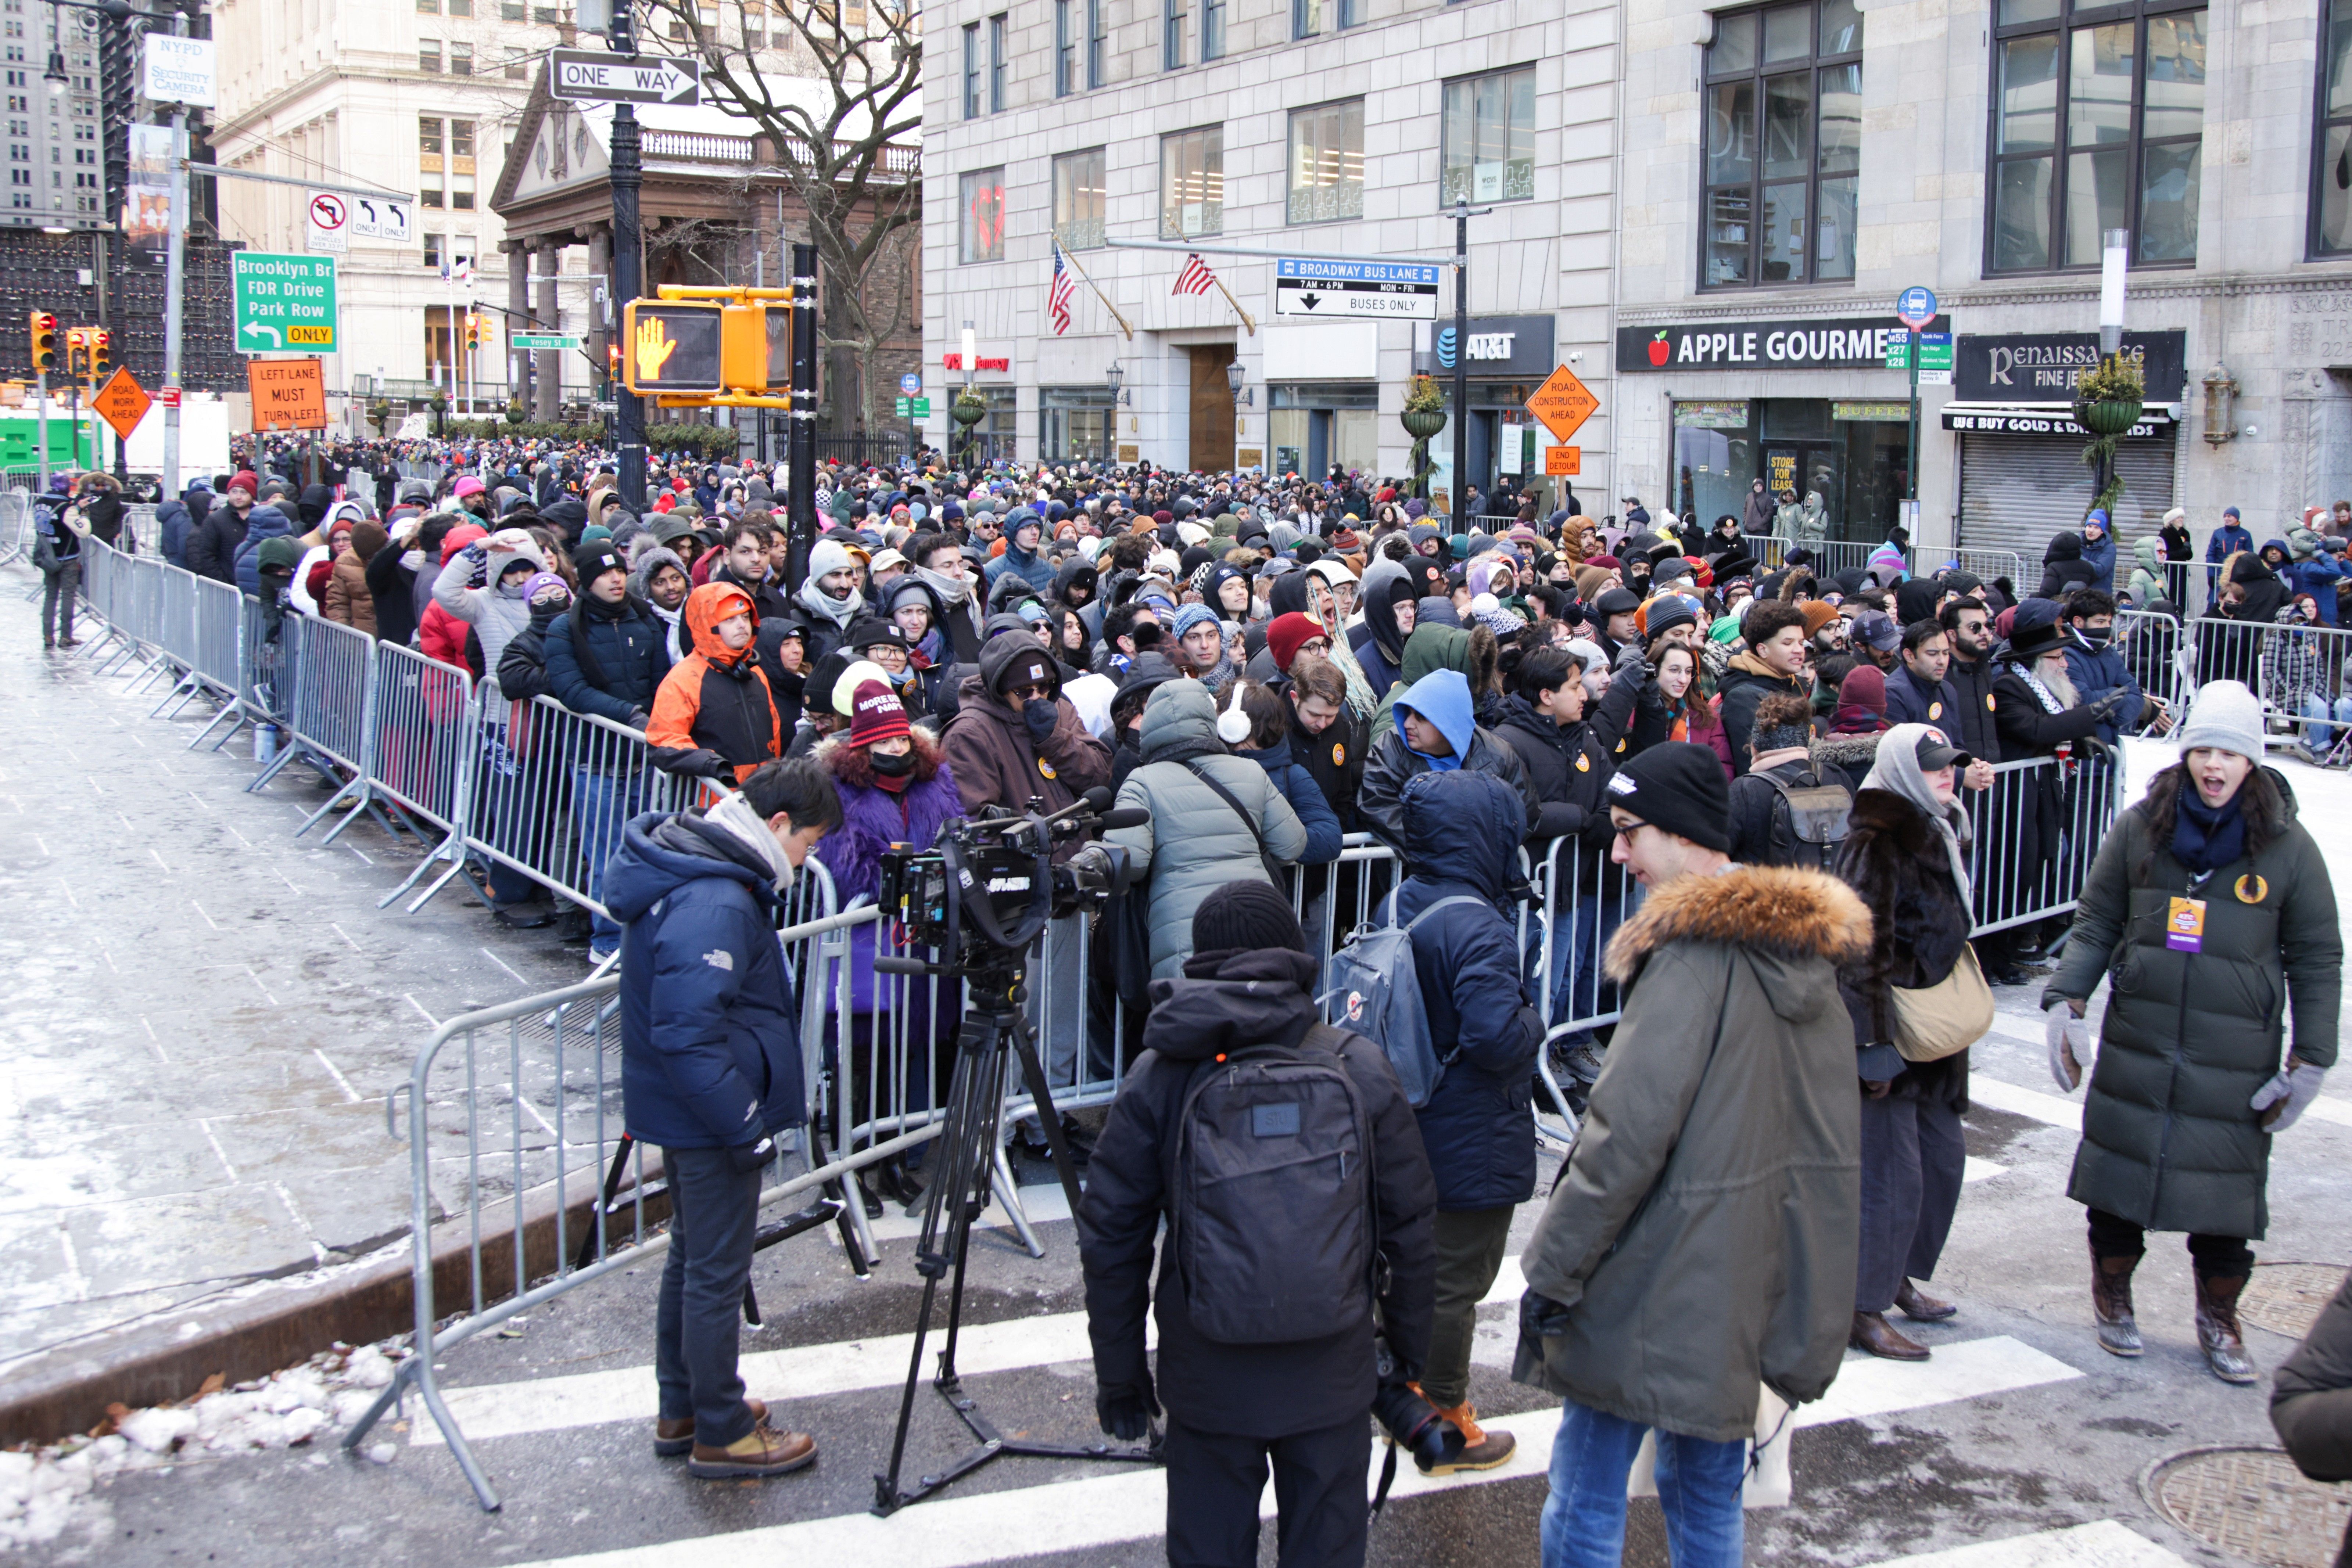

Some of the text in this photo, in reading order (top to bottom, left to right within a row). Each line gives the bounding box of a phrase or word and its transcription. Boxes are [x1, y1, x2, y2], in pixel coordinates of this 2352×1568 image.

[161, 40, 202, 55] NYPD
[152, 65, 209, 83] SECURITY
[567, 65, 680, 90] ONE WAY
[154, 78, 206, 95] CAMERA
[356, 223, 377, 233] ONLY
[385, 227, 406, 237] ONLY
[313, 235, 341, 243] VEHICLES
[238, 259, 308, 279] Brooklyn
[1299, 263, 1418, 280] BROADWAY BUS LANE
[248, 281, 325, 297] FDR Drive
[1380, 283, 1396, 292] MON
[1403, 285, 1415, 293] FRI
[249, 301, 325, 317] Park Row
[1351, 298, 1416, 311] BUSES ONLY
[1908, 315, 1932, 326] STANDING
[291, 328, 328, 341] ONLY
[1888, 333, 1907, 343] M55
[530, 338, 552, 348] Vesey
[1466, 332, 1515, 360] AT&T
[1677, 328, 1908, 363] APPLE GOURME
[975, 355, 1010, 372] harmacy
[261, 368, 316, 380] LEFT LANE
[2035, 370, 2063, 386] FINE
[112, 385, 135, 395] ROAD
[1551, 383, 1576, 392] ROAD
[272, 388, 305, 402] MUST
[1535, 396, 1588, 406] CONSTRUCTION
[112, 398, 136, 407] WORK
[111, 410, 139, 419] AHEAD
[263, 409, 318, 421] TURN LEFT
[1550, 410, 1575, 419] AHEAD
[1838, 406, 1908, 416] BUFFET
[1953, 417, 1974, 429] WE
[1978, 417, 2006, 430] BUY
[2008, 418, 2050, 432] GOLD
[2054, 422, 2065, 433] &
[1771, 456, 1795, 468] STORE
[1775, 468, 1790, 479] FOR
[1771, 479, 1793, 490] LEASE
[858, 695, 889, 712] MORE
